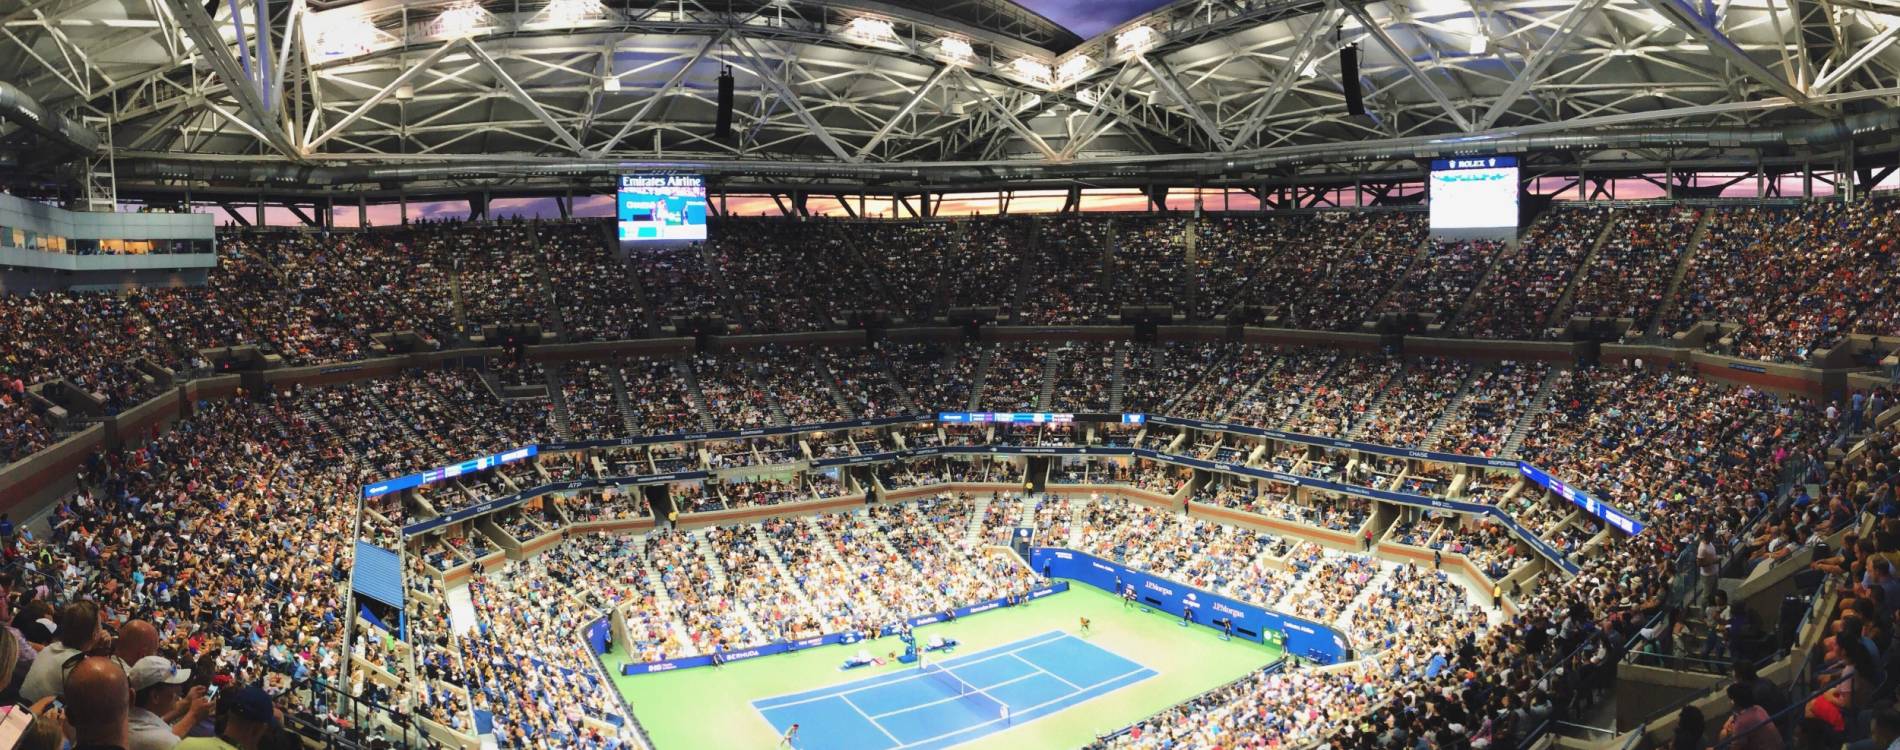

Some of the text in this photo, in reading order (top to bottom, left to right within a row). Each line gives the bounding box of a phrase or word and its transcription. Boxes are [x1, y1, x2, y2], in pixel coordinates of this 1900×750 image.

[1458, 160, 1486, 168] ROLEX
[623, 176, 702, 187] Emirates Airline
[620, 437, 633, 445] IBM
[1408, 451, 1429, 459] CHASE
[726, 650, 760, 661] BERMUDA
